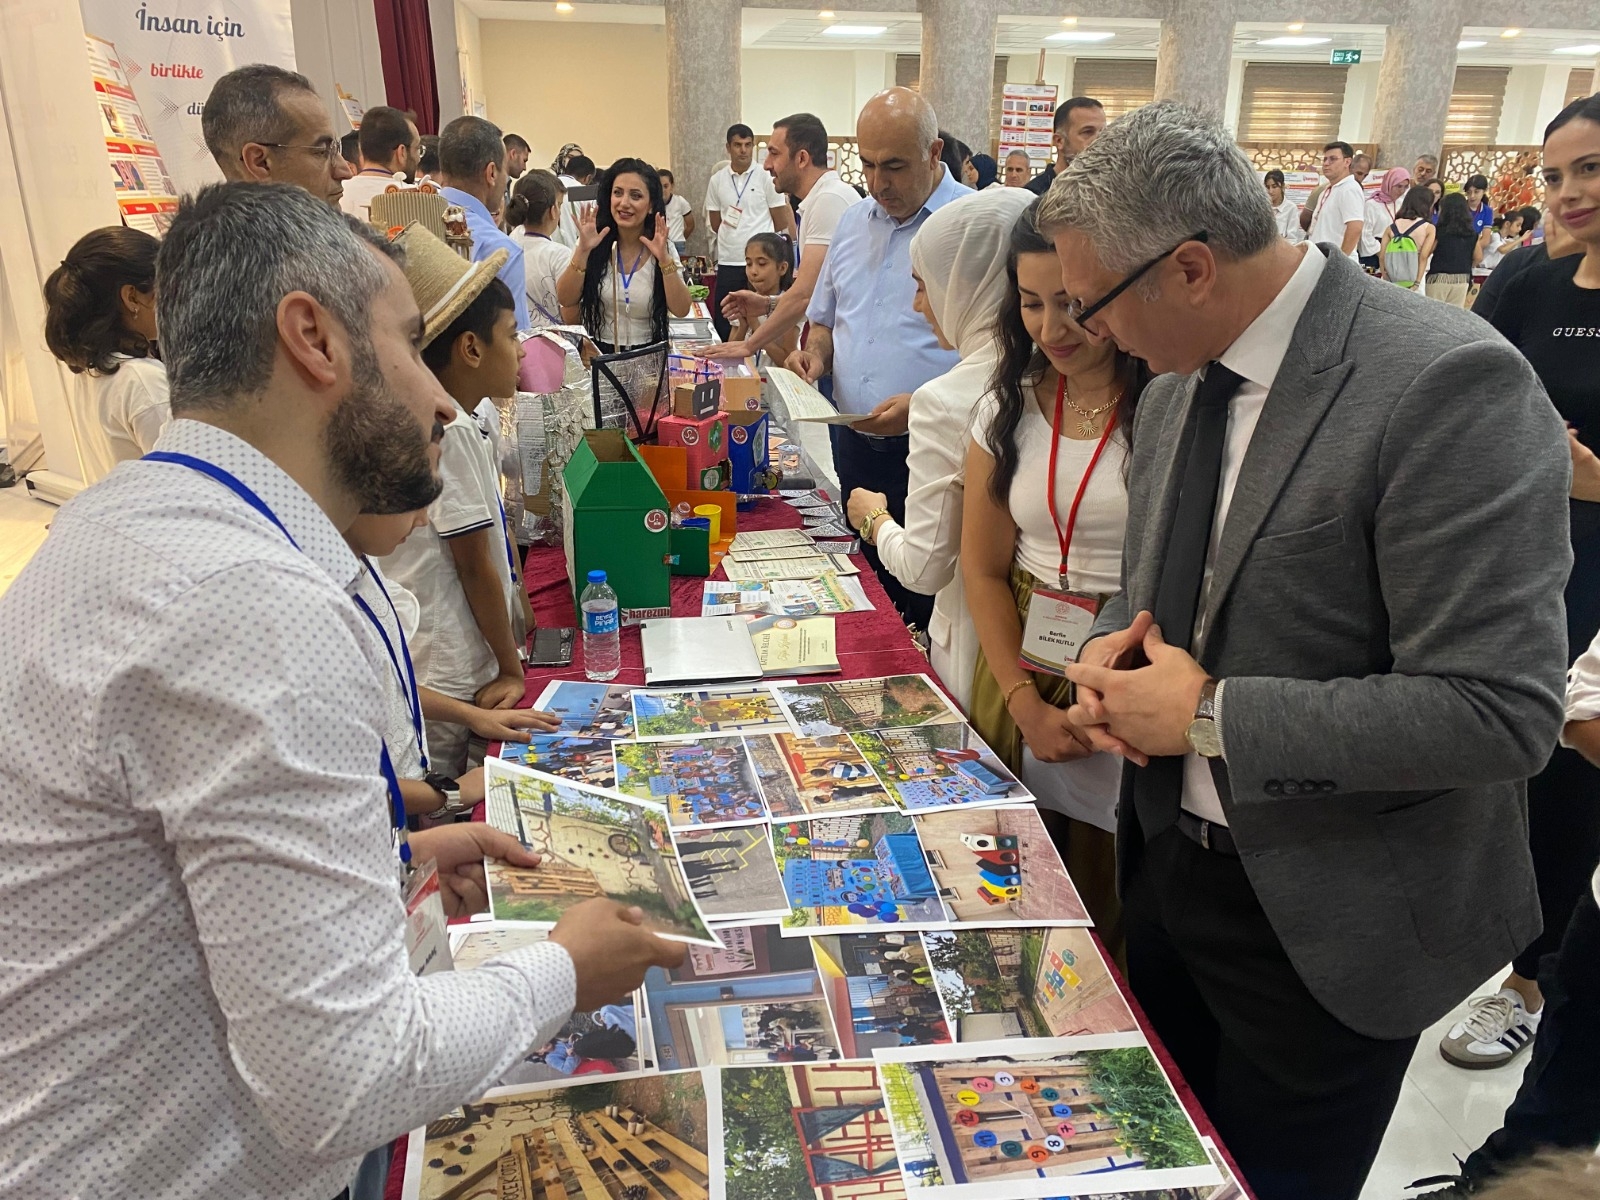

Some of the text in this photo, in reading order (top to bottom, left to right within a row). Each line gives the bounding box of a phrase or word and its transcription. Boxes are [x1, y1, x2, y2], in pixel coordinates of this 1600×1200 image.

[135, 2, 245, 41] İnsan için
[150, 63, 204, 79] birlikte
[959, 1112, 974, 1126] 12
[1060, 1124, 1073, 1133] 7
[979, 1134, 993, 1145] 11
[1047, 1140, 1061, 1148] 8
[1031, 1150, 1046, 1158] 9
